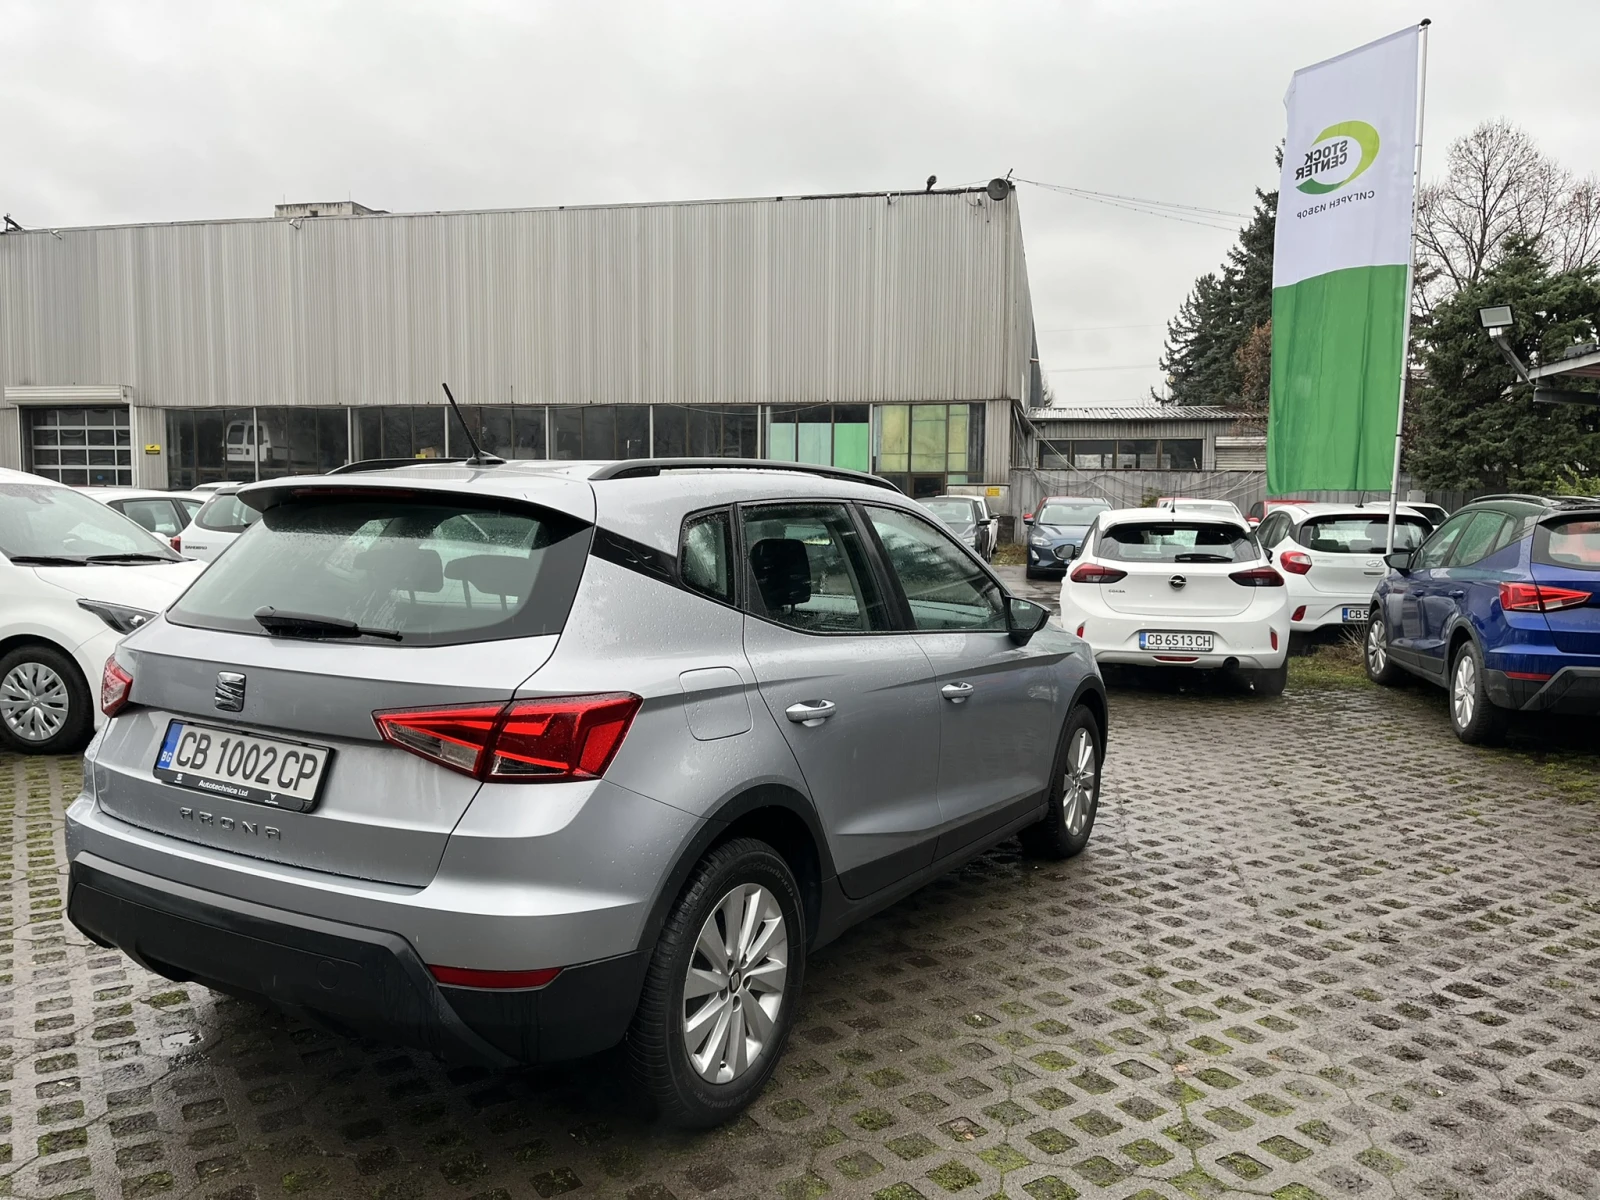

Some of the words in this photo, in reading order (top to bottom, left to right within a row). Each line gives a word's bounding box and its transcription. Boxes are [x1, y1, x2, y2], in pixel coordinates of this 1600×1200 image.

[1349, 610, 1362, 618] CB
[1147, 634, 1163, 646] CB
[1165, 634, 1193, 646] 6513
[1195, 635, 1211, 647] CH
[161, 751, 172, 762] BG
[176, 731, 212, 770] CB
[215, 737, 278, 785] 1002
[277, 750, 318, 791] CP
[198, 779, 238, 794] Autotechnica
[238, 788, 249, 797] Ltd
[179, 806, 281, 841] ARONA
